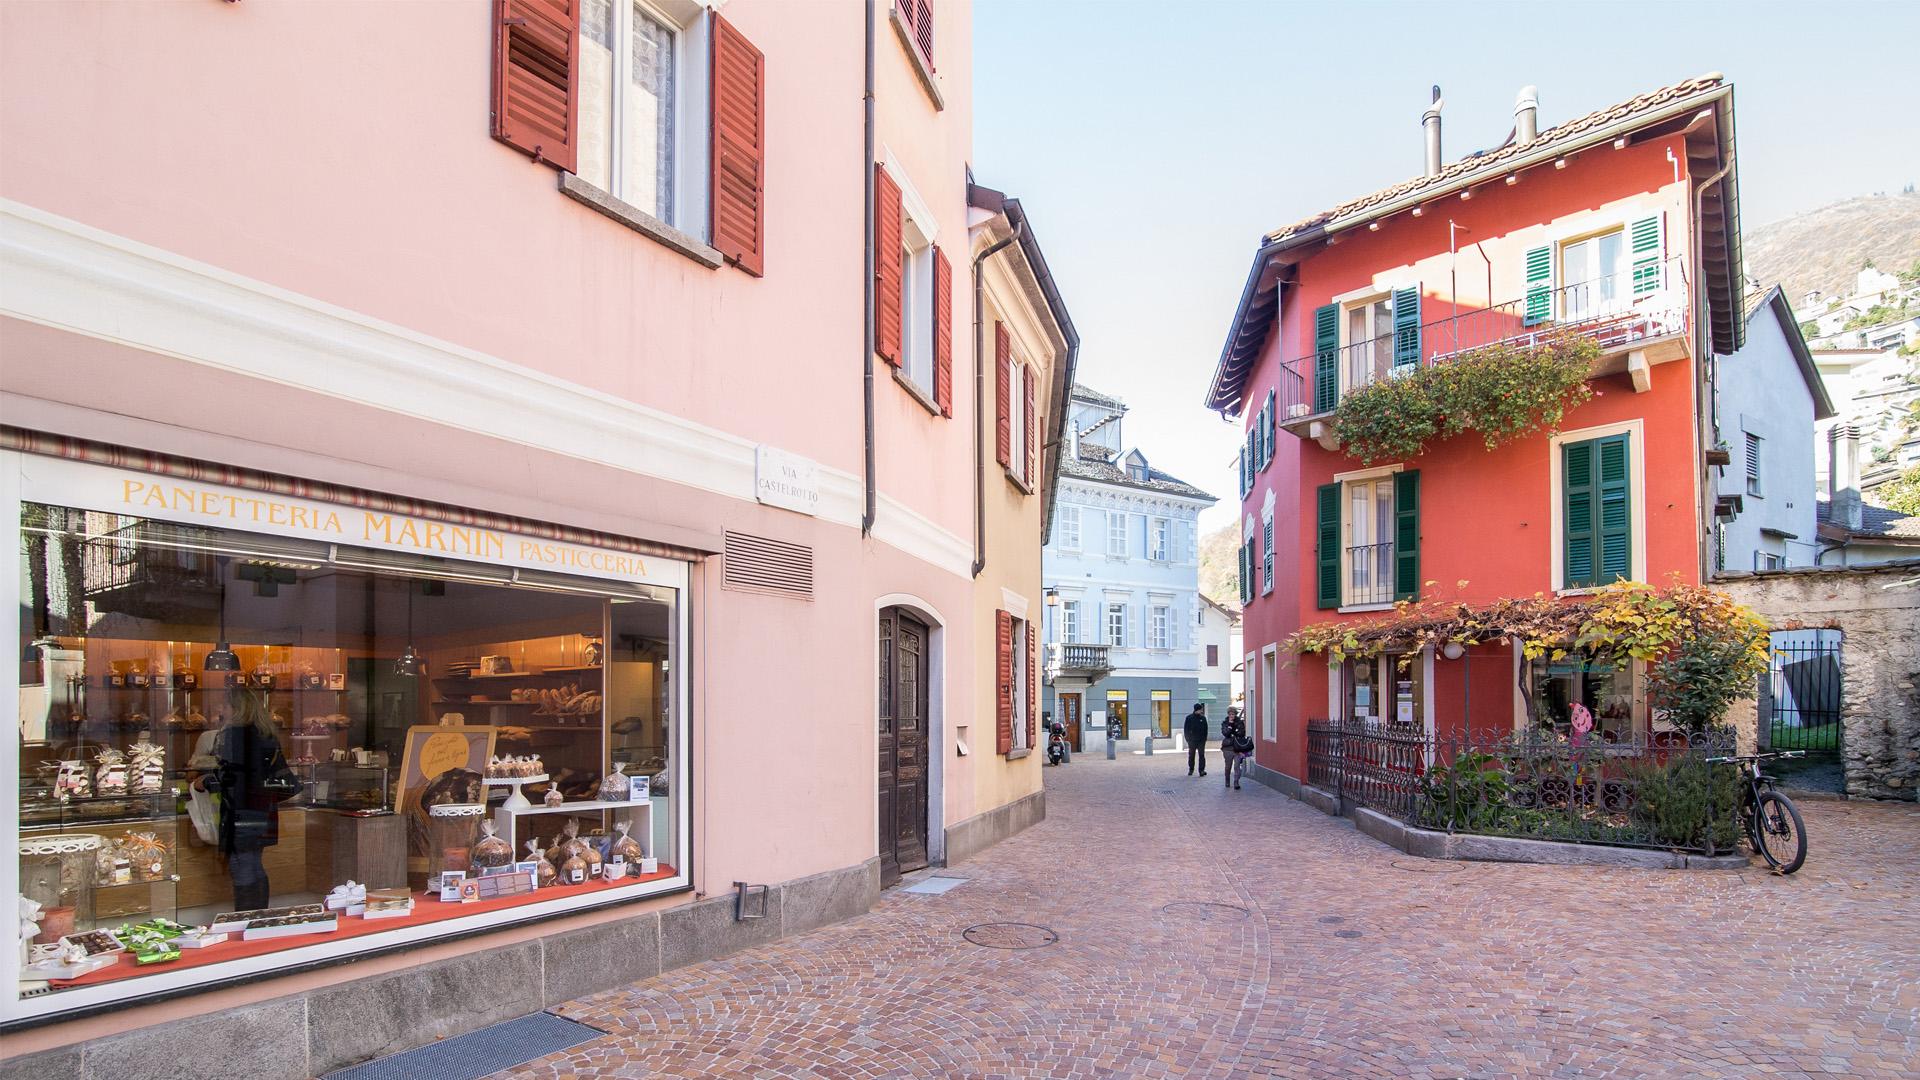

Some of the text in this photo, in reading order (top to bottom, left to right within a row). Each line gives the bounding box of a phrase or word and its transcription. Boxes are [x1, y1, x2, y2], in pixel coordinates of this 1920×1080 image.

[782, 466, 797, 479] VIA
[759, 479, 818, 502] CASTELROTTO
[123, 480, 648, 577] PANETTERIA MARNIN PASTICCERIA
